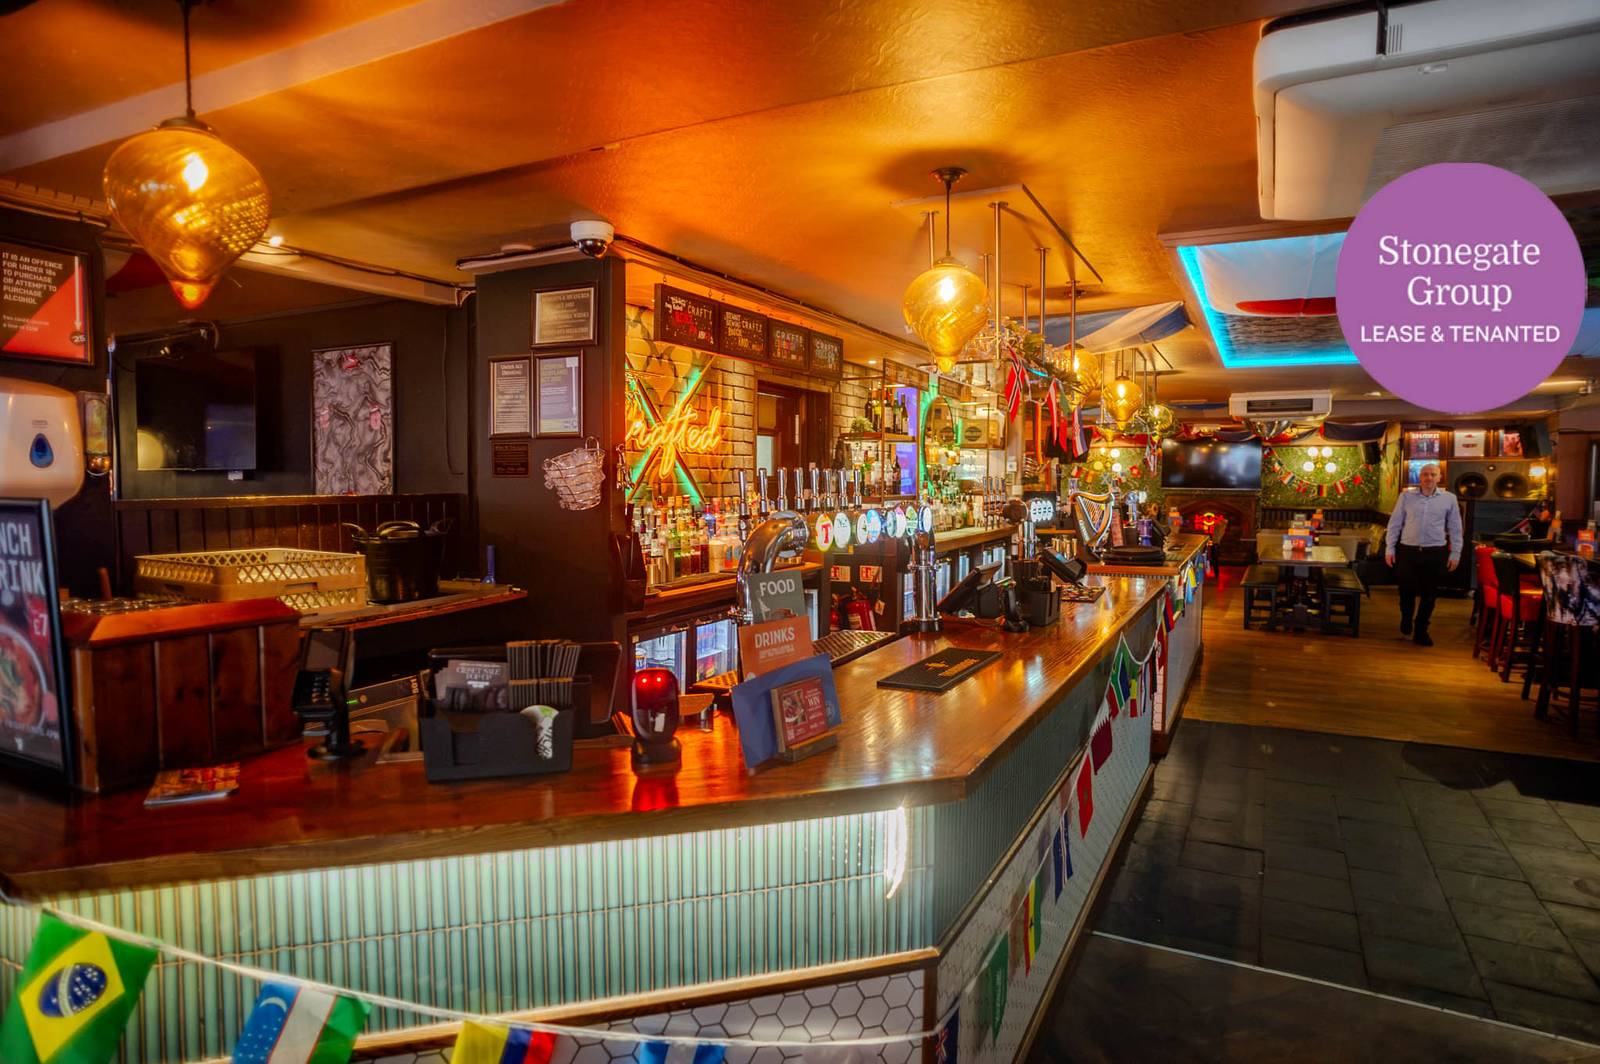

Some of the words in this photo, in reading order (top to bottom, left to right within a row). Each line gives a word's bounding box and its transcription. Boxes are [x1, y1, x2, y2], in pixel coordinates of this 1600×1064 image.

[2, 260, 17, 269] FOR
[19, 263, 44, 274] UNDER
[31, 258, 63, 270] OFFENCE
[14, 270, 53, 284] PURCHASE
[15, 279, 47, 290] ATTEMPT
[3, 285, 42, 298] PURCHASE
[3, 294, 37, 305] ALCOHOL
[759, 578, 796, 597] FOOD
[754, 626, 796, 648] DRINKS
